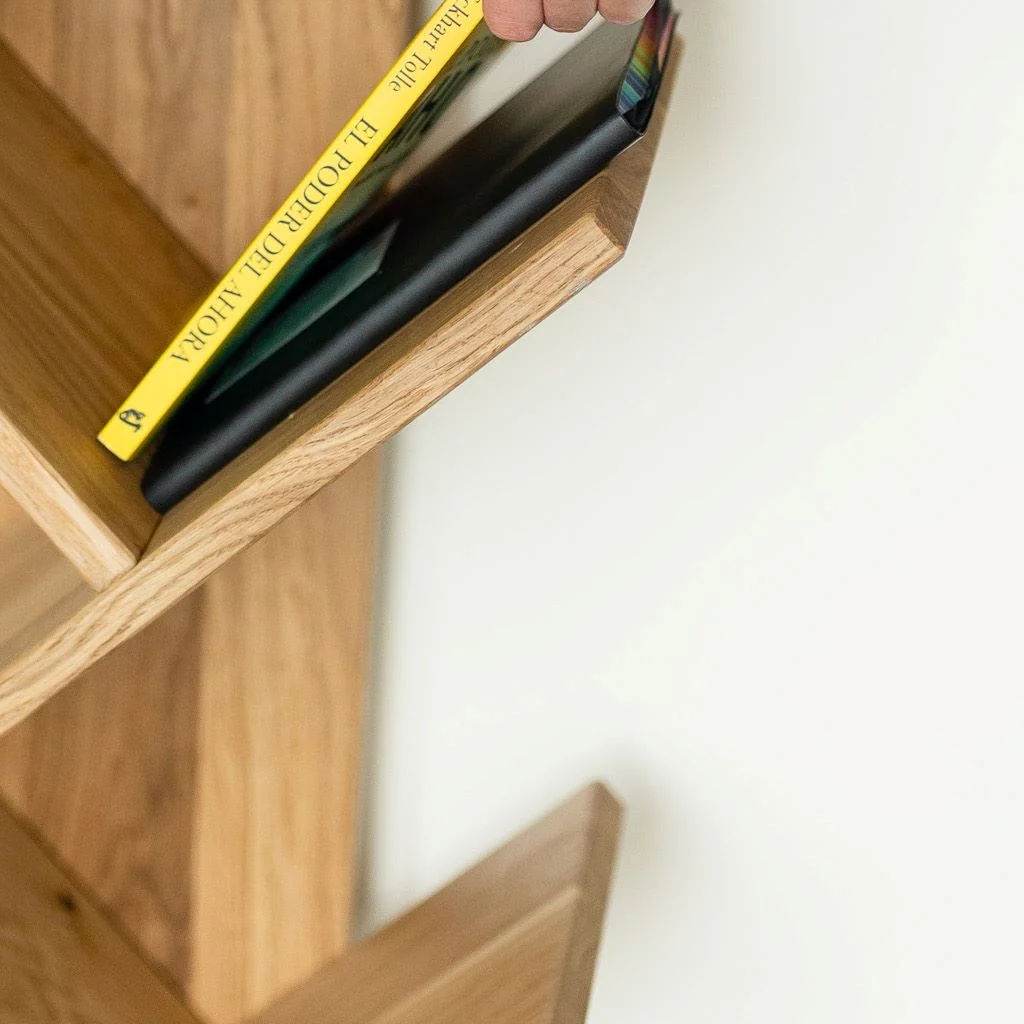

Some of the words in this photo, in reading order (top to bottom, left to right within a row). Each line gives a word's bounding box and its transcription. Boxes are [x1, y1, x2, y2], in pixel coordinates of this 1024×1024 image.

[388, 52, 432, 93] Tolle
[344, 117, 379, 148] EL
[277, 150, 354, 233] PODER
[238, 231, 286, 278] DEL
[170, 283, 243, 364] AHORA
